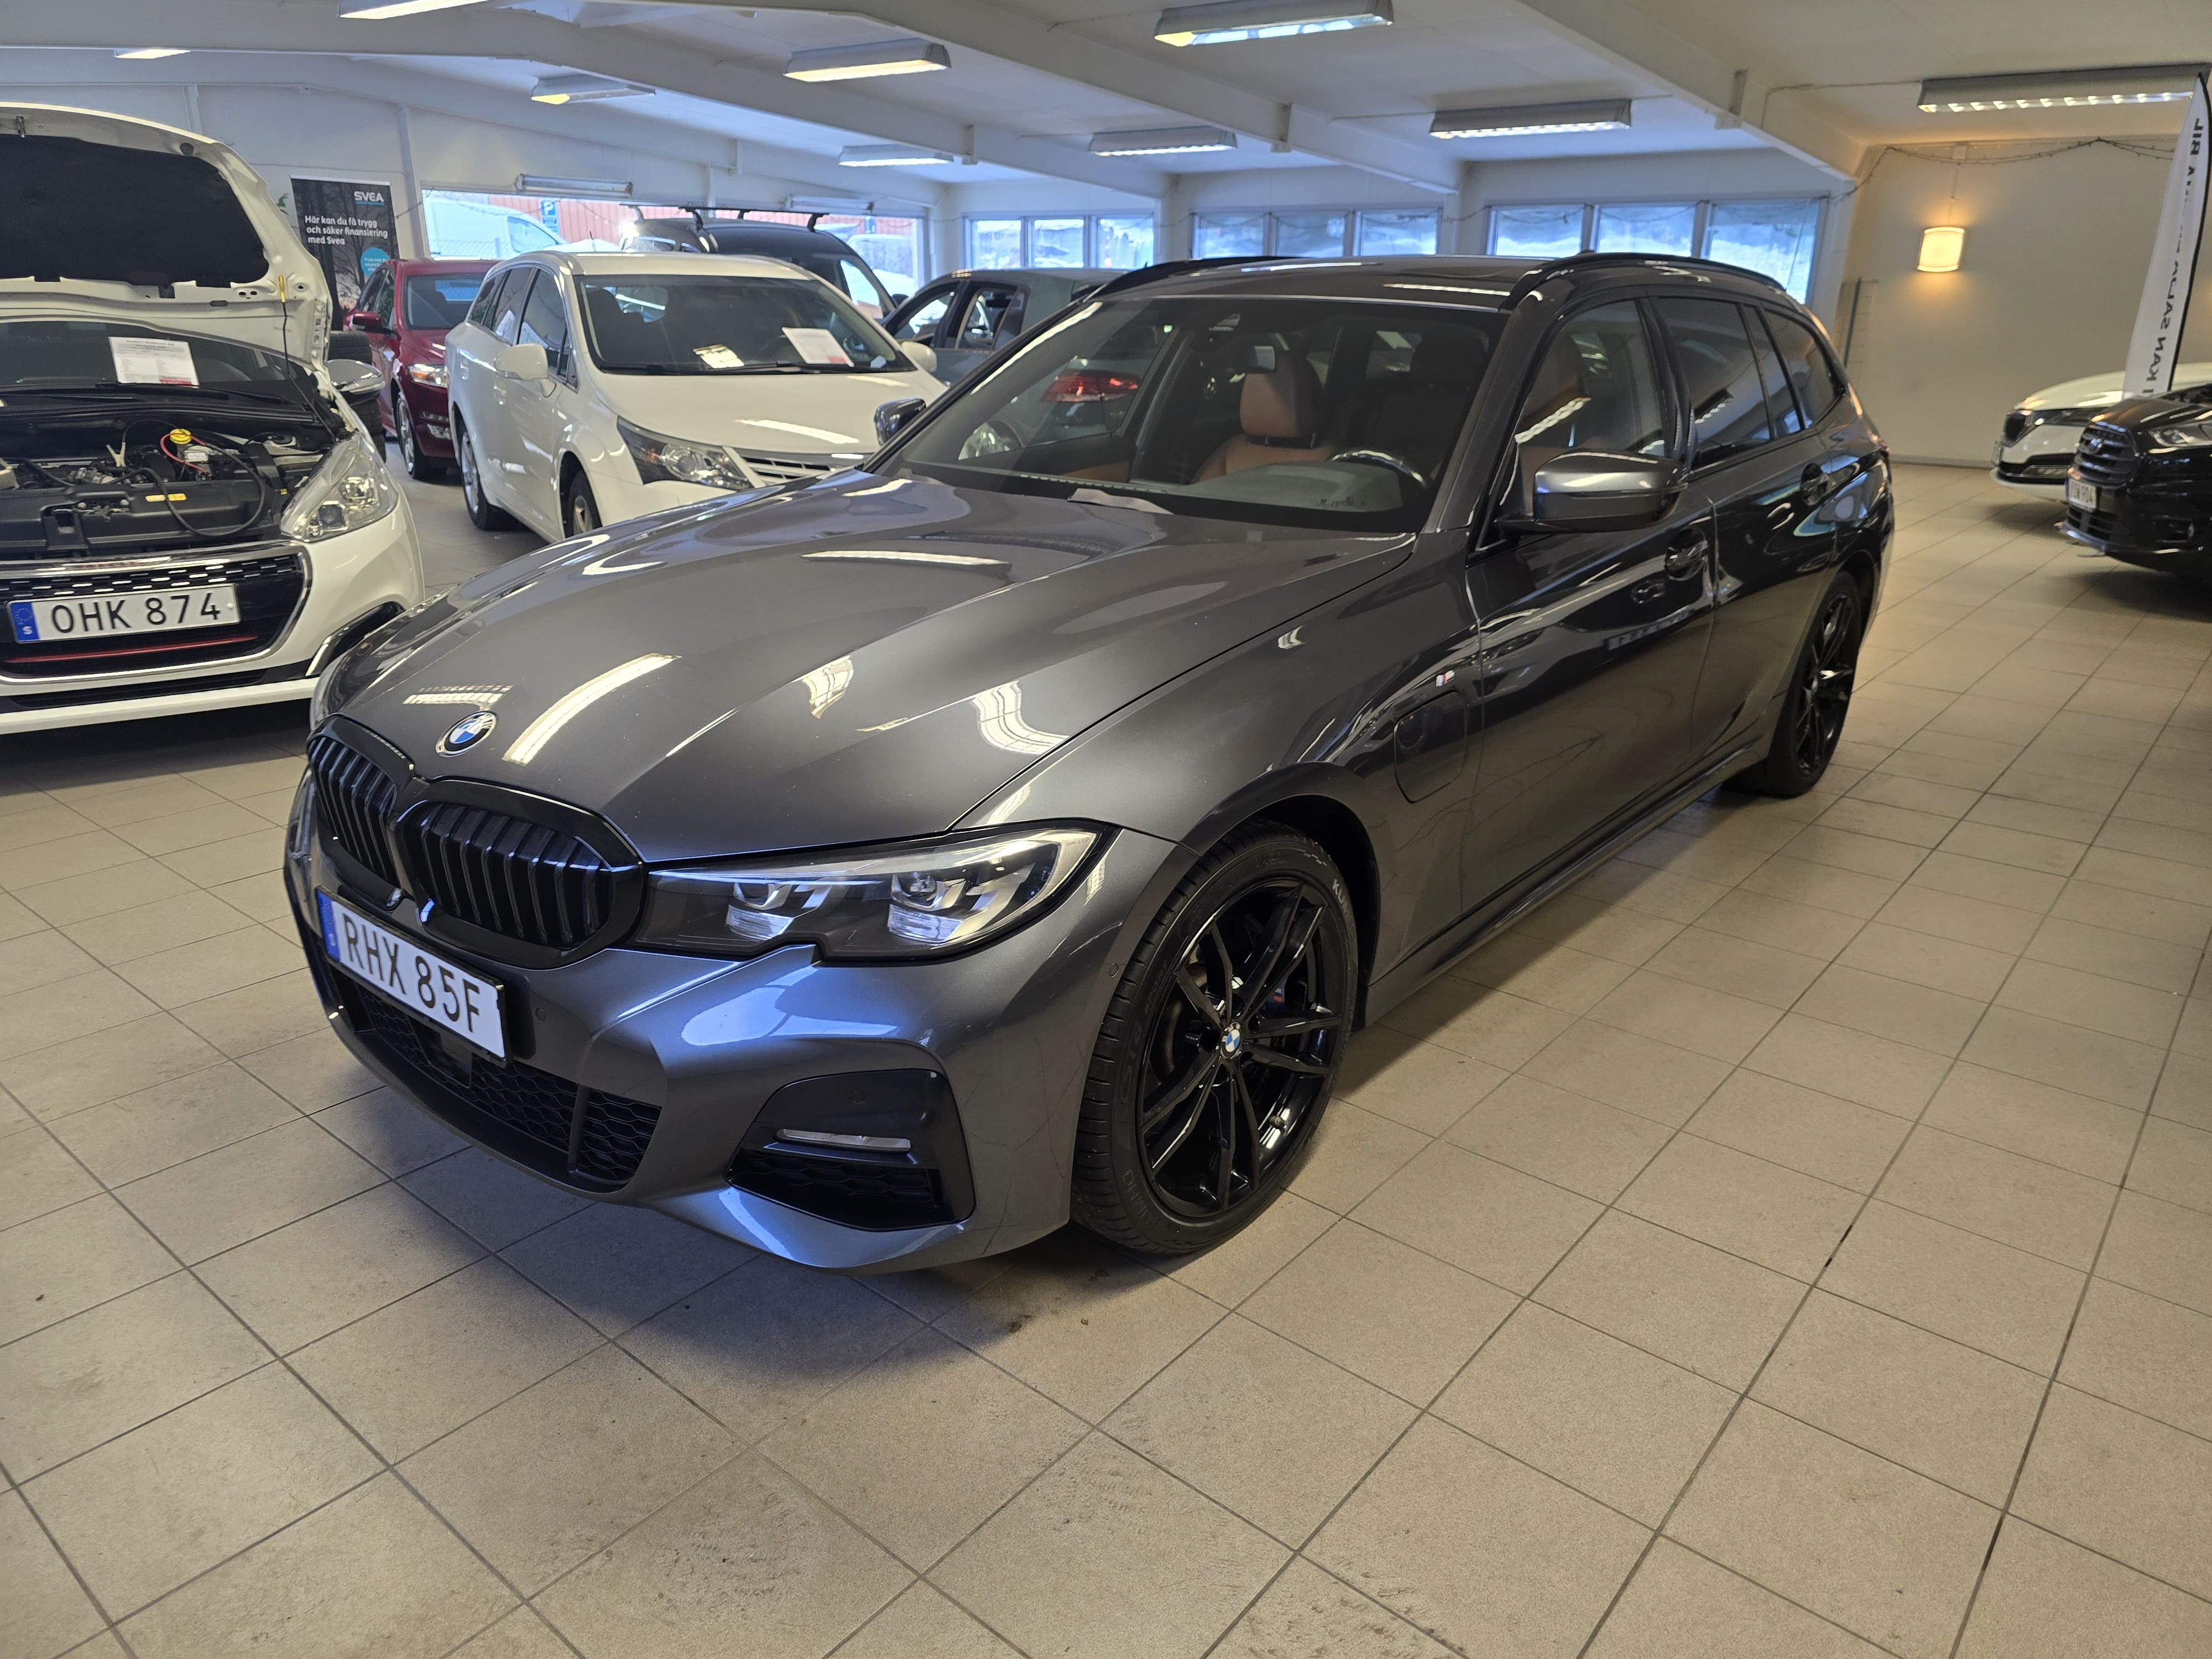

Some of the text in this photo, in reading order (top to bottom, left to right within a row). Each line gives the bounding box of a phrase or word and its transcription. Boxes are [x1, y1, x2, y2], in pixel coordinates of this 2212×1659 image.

[354, 191, 384, 202] SVEA
[305, 215, 377, 228] Här kan du få trygg
[306, 226, 388, 239] och säker finansiering
[308, 236, 326, 244] med
[51, 593, 220, 633] OHK 874
[22, 626, 33, 635] S
[342, 914, 481, 1032] RHX 85F
